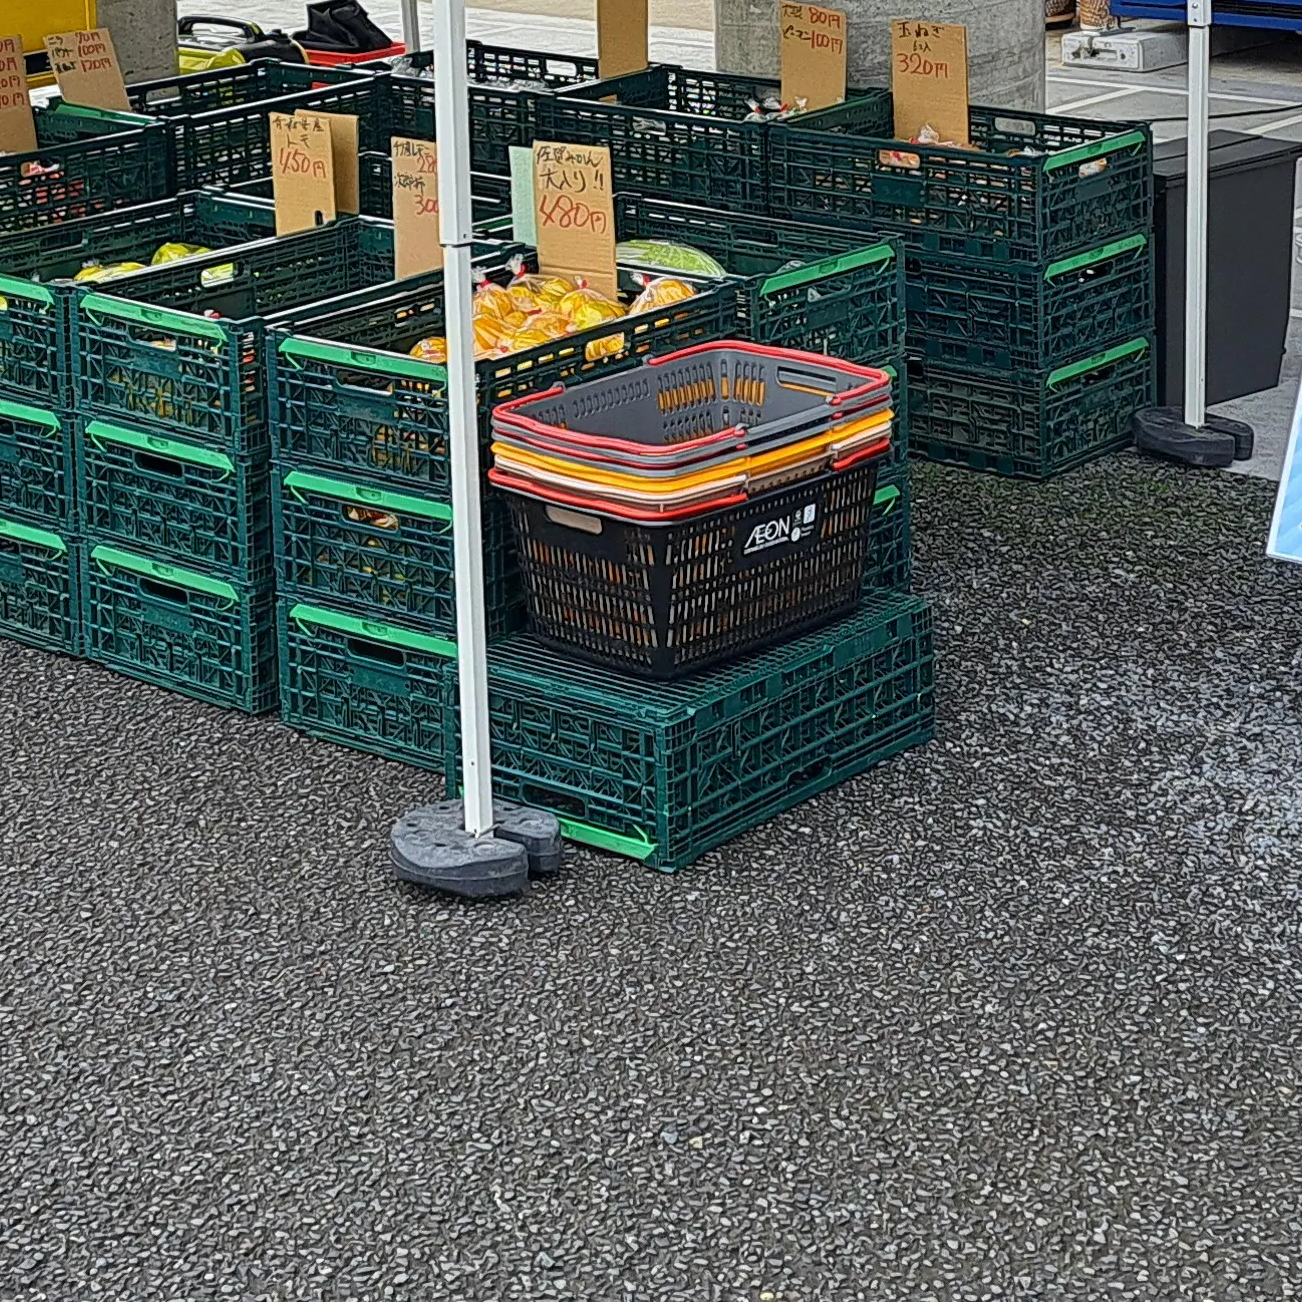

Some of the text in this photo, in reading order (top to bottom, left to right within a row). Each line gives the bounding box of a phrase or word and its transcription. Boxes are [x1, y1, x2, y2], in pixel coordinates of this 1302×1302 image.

[808, 7, 841, 29] 80円
[897, 21, 945, 39] 玉ねぎ
[77, 44, 107, 58] 100円
[810, 31, 843, 54] 100円
[81, 57, 113, 73] 120円
[897, 53, 949, 79] 320円
[279, 146, 328, 179] 450円
[539, 195, 607, 235] 480円
